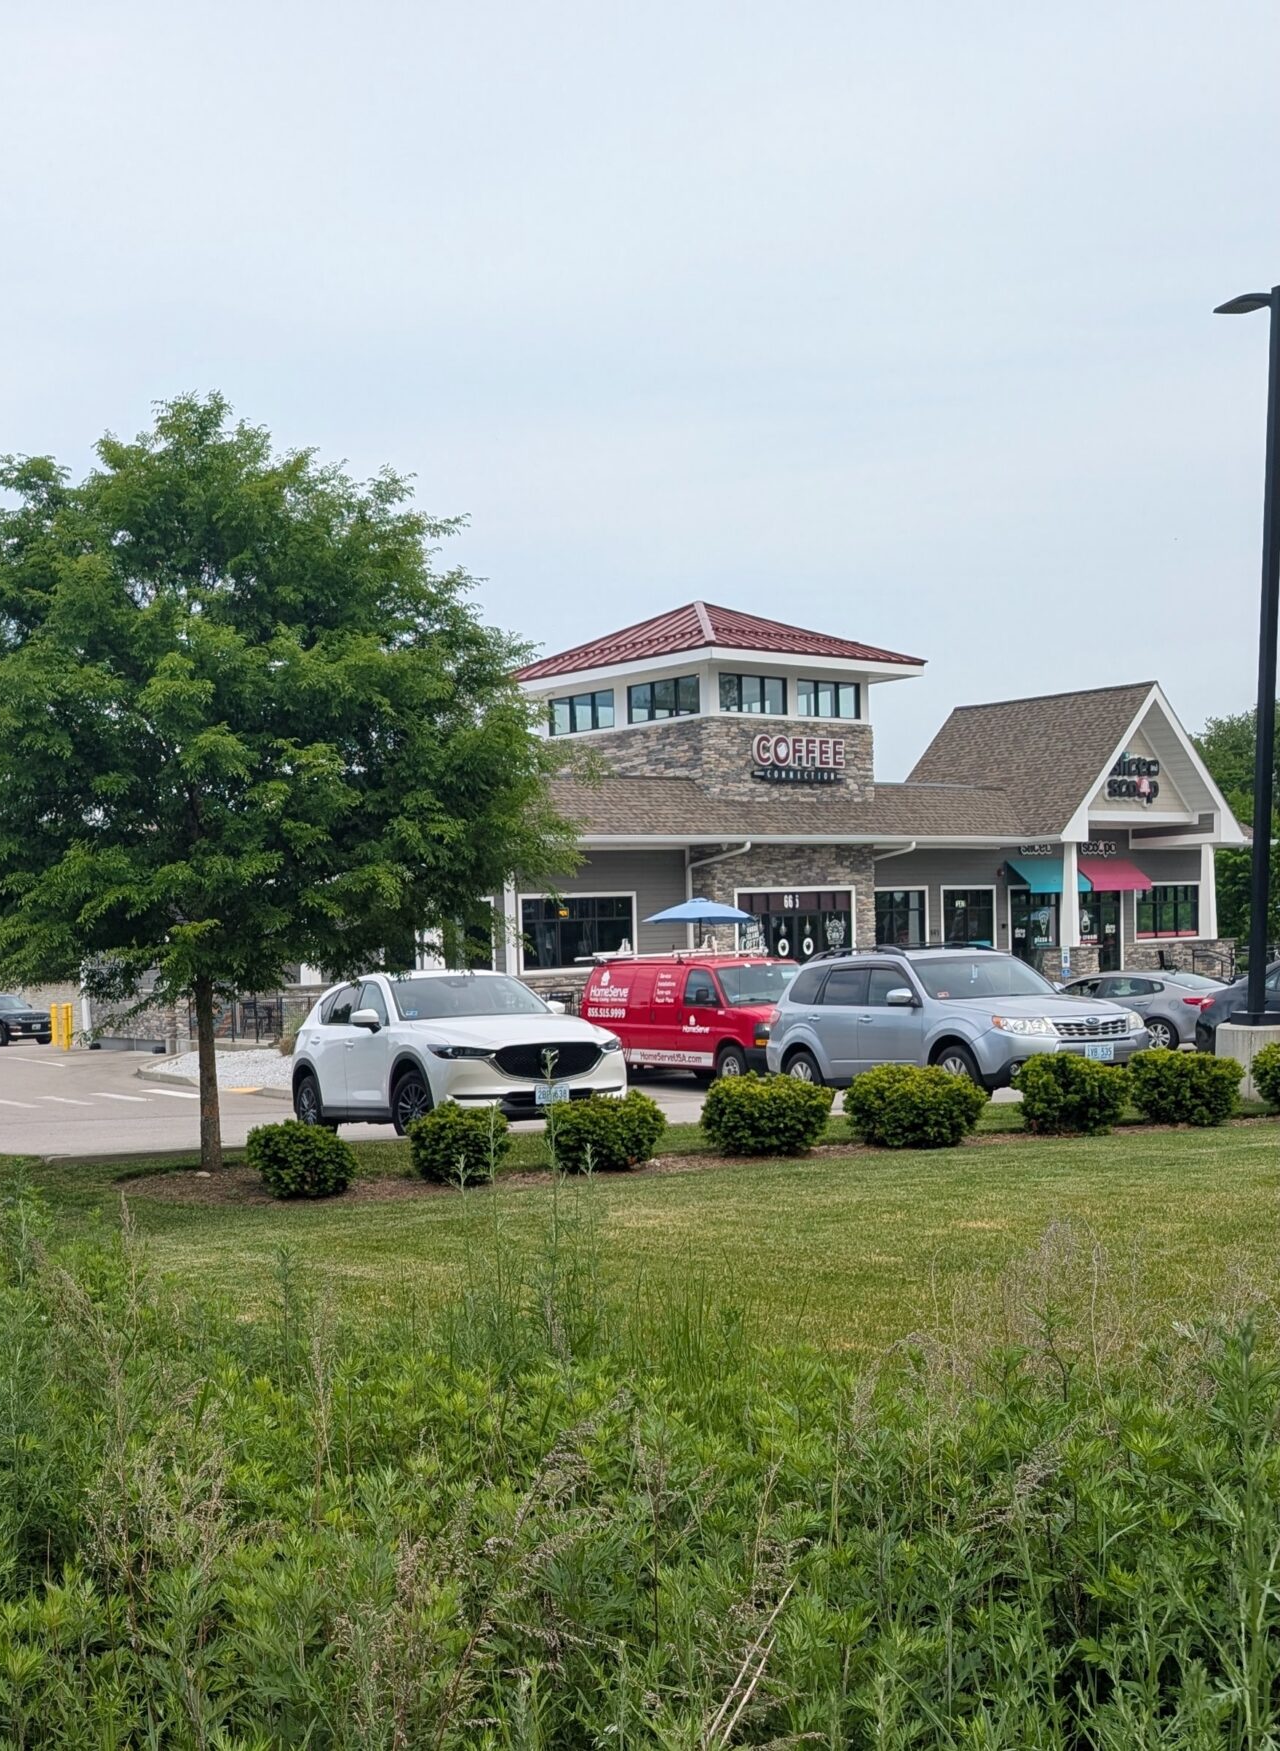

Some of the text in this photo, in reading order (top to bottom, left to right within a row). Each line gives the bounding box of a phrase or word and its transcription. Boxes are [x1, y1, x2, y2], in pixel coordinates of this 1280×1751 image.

[753, 734, 845, 768] COFFEE
[767, 770, 834, 780] CONNECTION
[590, 985, 629, 998] HomeServe
[682, 1025, 710, 1034] HomeServe
[640, 1052, 702, 1063] HomeServeUSA.com
